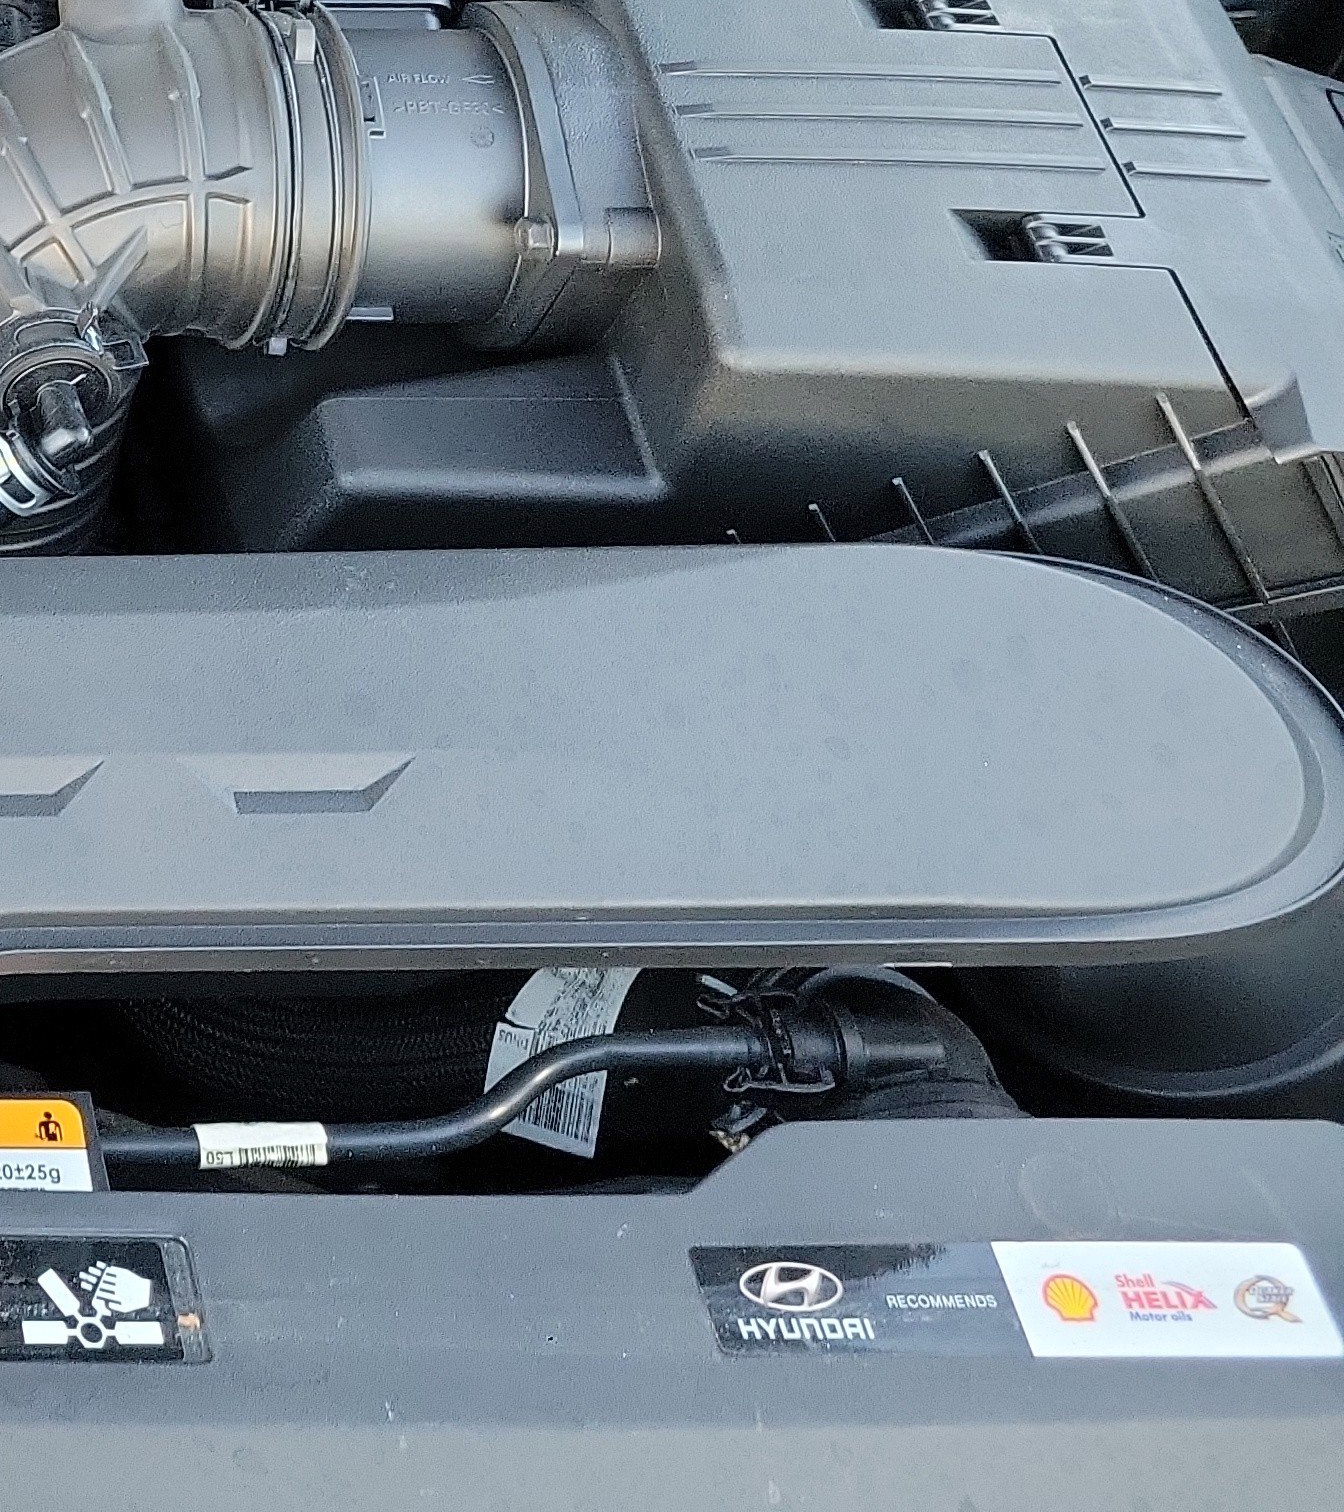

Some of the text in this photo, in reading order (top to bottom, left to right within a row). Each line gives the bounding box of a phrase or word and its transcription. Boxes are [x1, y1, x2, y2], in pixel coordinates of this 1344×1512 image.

[387, 73, 450, 85] AIR FLOW
[1114, 1273, 1156, 1289] Shell
[1123, 1289, 1216, 1310] HELIX
[738, 1293, 998, 1340] HYUNDAI RECOMMENDS
[1130, 1310, 1193, 1322] Motor oils
